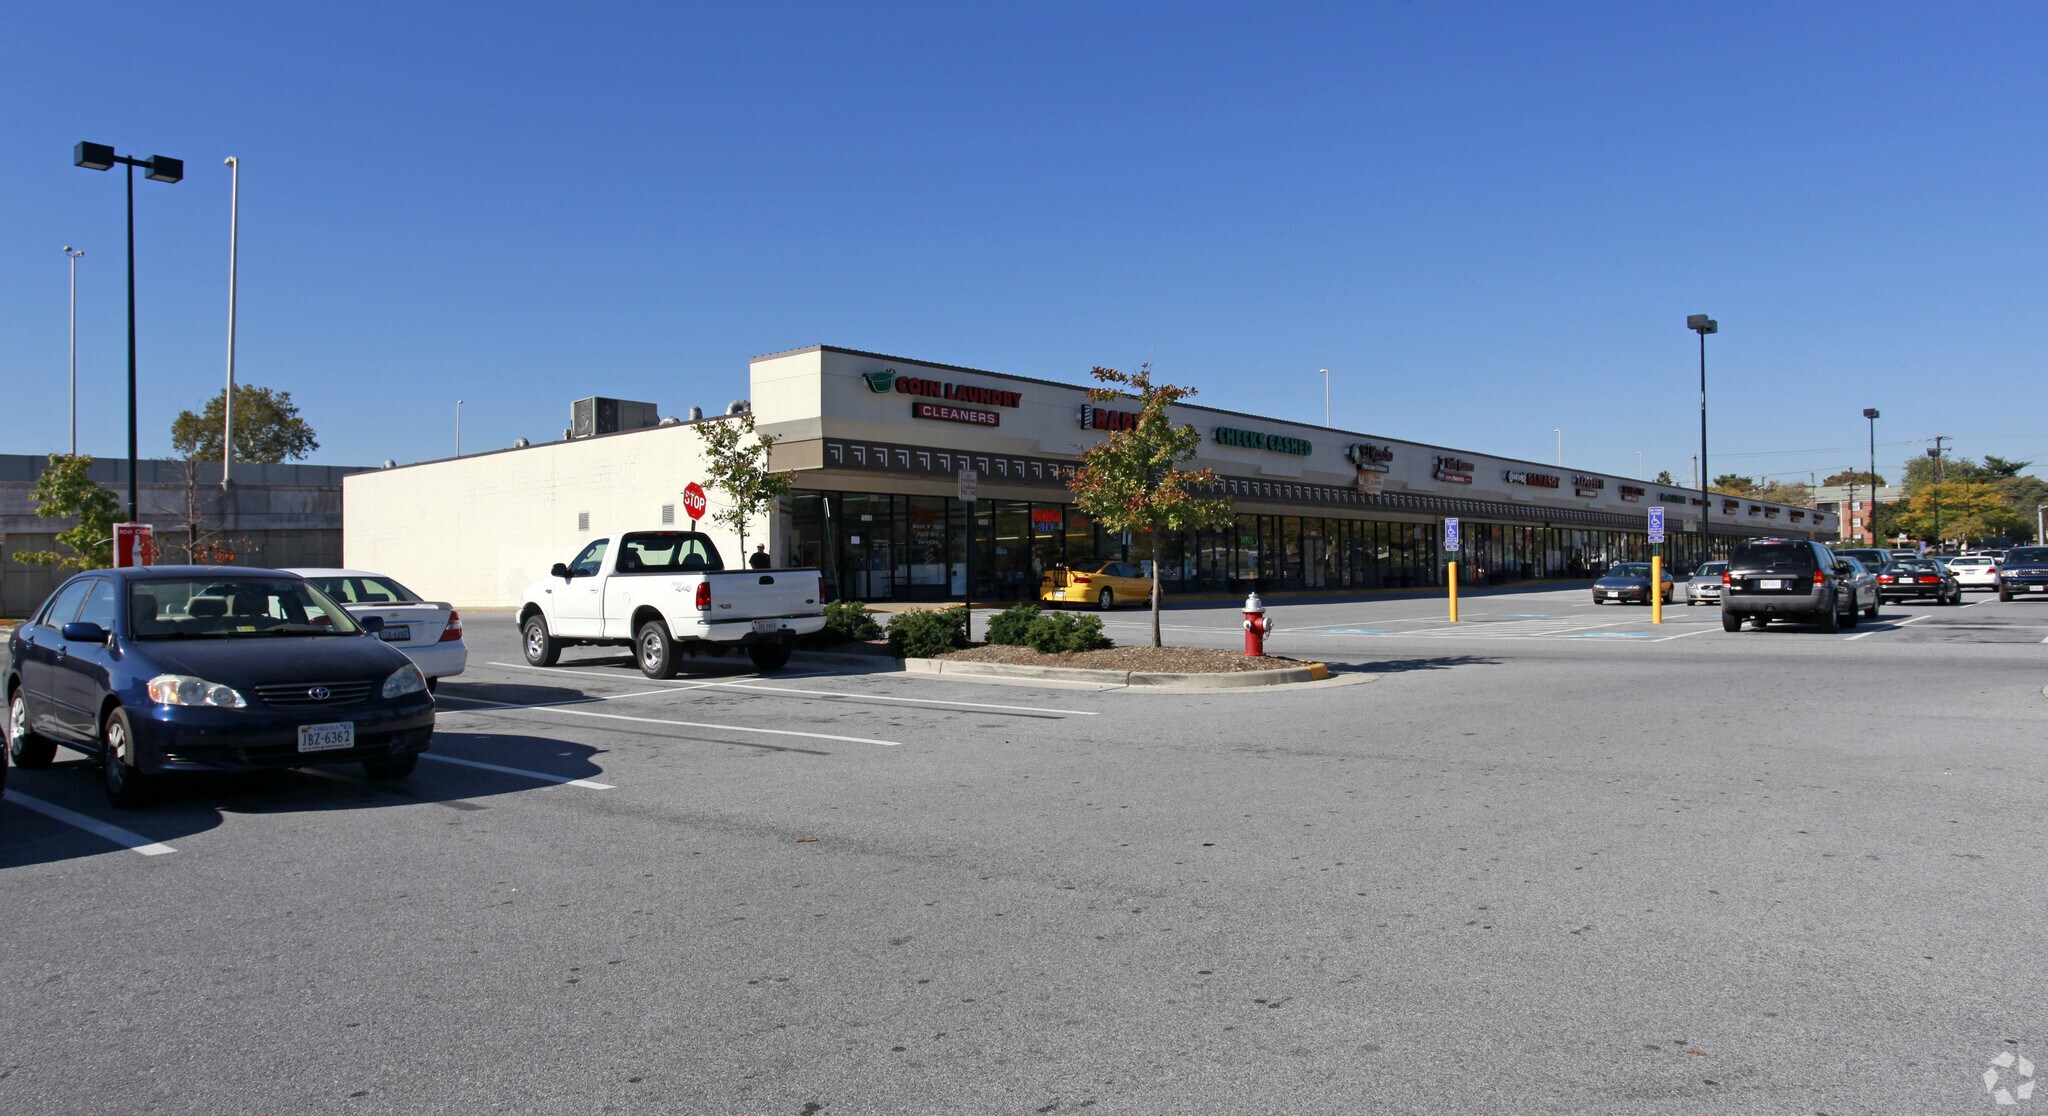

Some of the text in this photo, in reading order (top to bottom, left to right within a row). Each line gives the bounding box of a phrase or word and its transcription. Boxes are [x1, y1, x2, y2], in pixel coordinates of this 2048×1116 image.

[896, 376, 1022, 408] COIN LAUNDRY
[923, 405, 995, 424] CLEANERS
[1216, 427, 1312, 456] CHECKS CASHED
[684, 490, 705, 511] STOP
[302, 730, 350, 746] JBZ-6362
